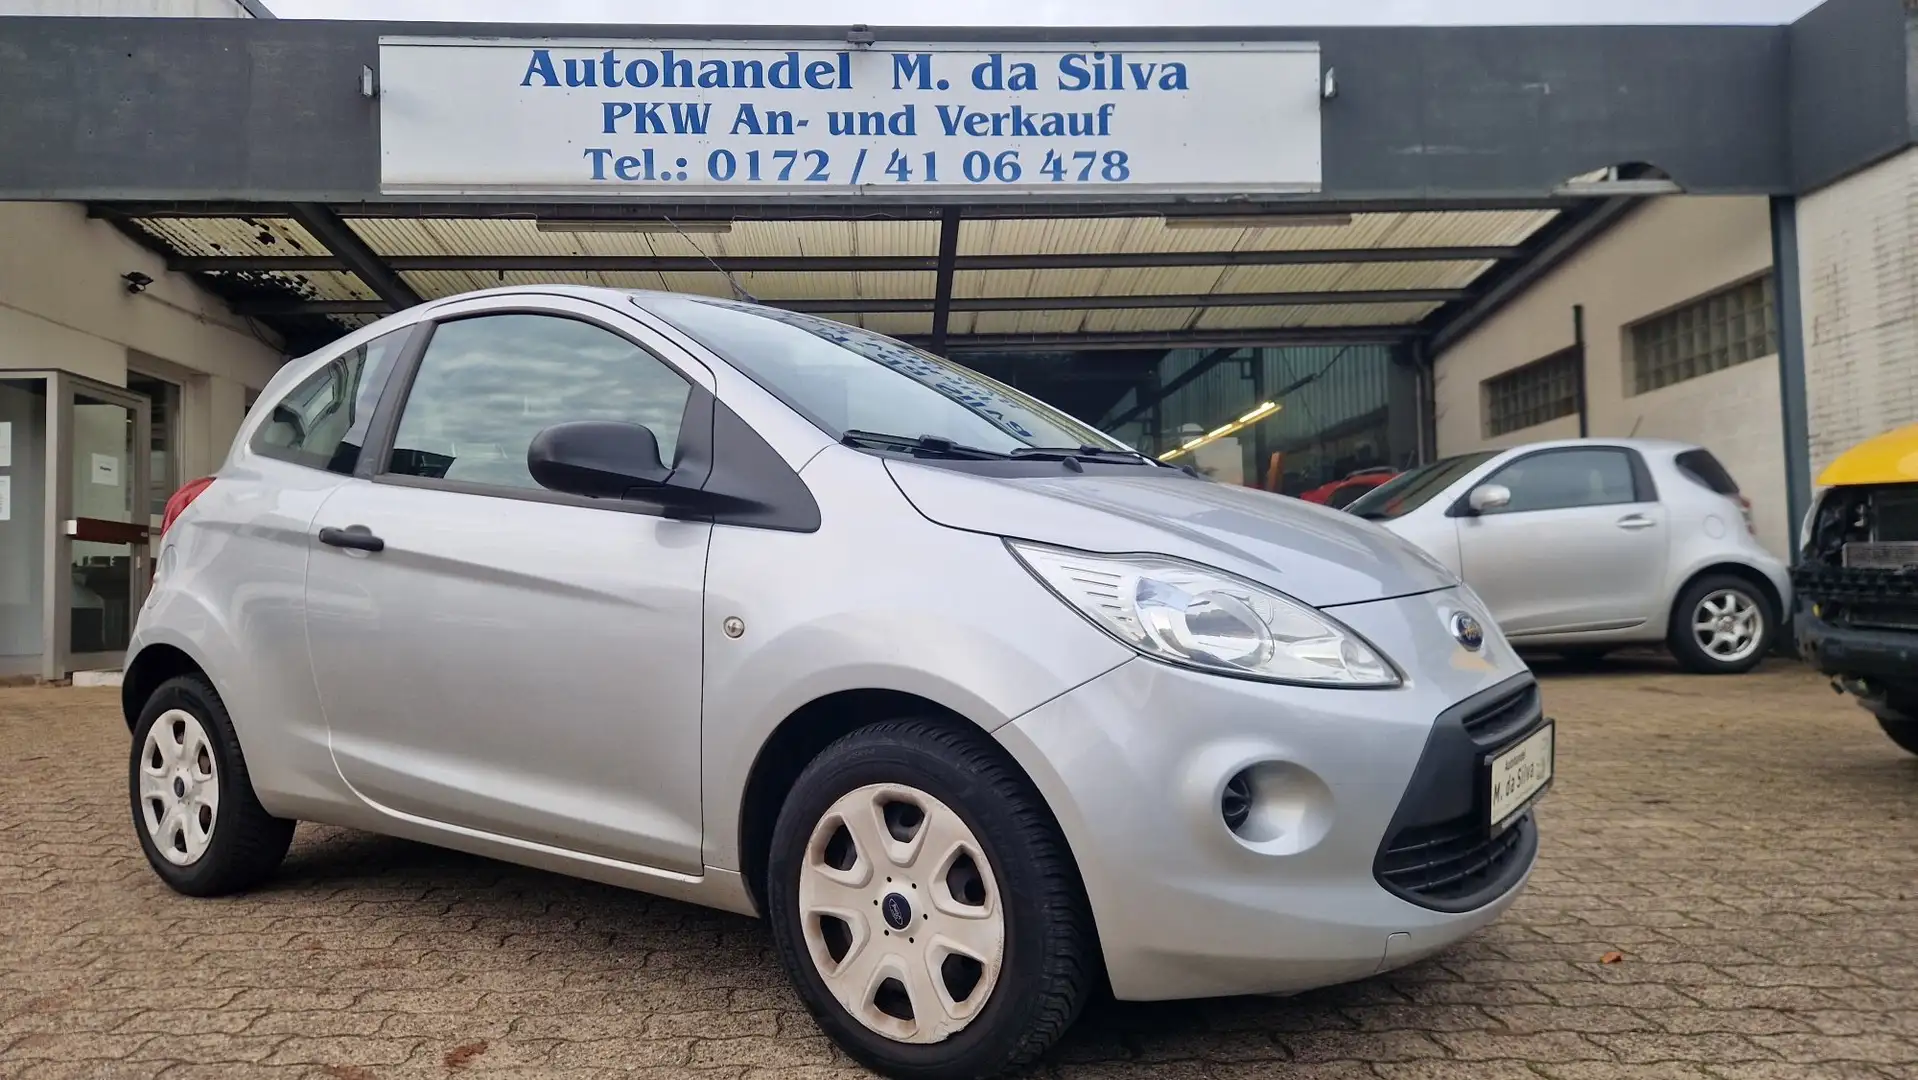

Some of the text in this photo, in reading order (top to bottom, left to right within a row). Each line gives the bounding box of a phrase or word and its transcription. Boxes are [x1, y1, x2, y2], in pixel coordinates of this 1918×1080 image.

[521, 48, 1191, 92] Autohandel M. da Silva
[602, 101, 1114, 137] PKW An- und Verkauf
[583, 148, 1130, 185] Tel.: 0172 / 41 06 478
[1505, 774, 1515, 796] da
[1516, 763, 1535, 788] Silva
